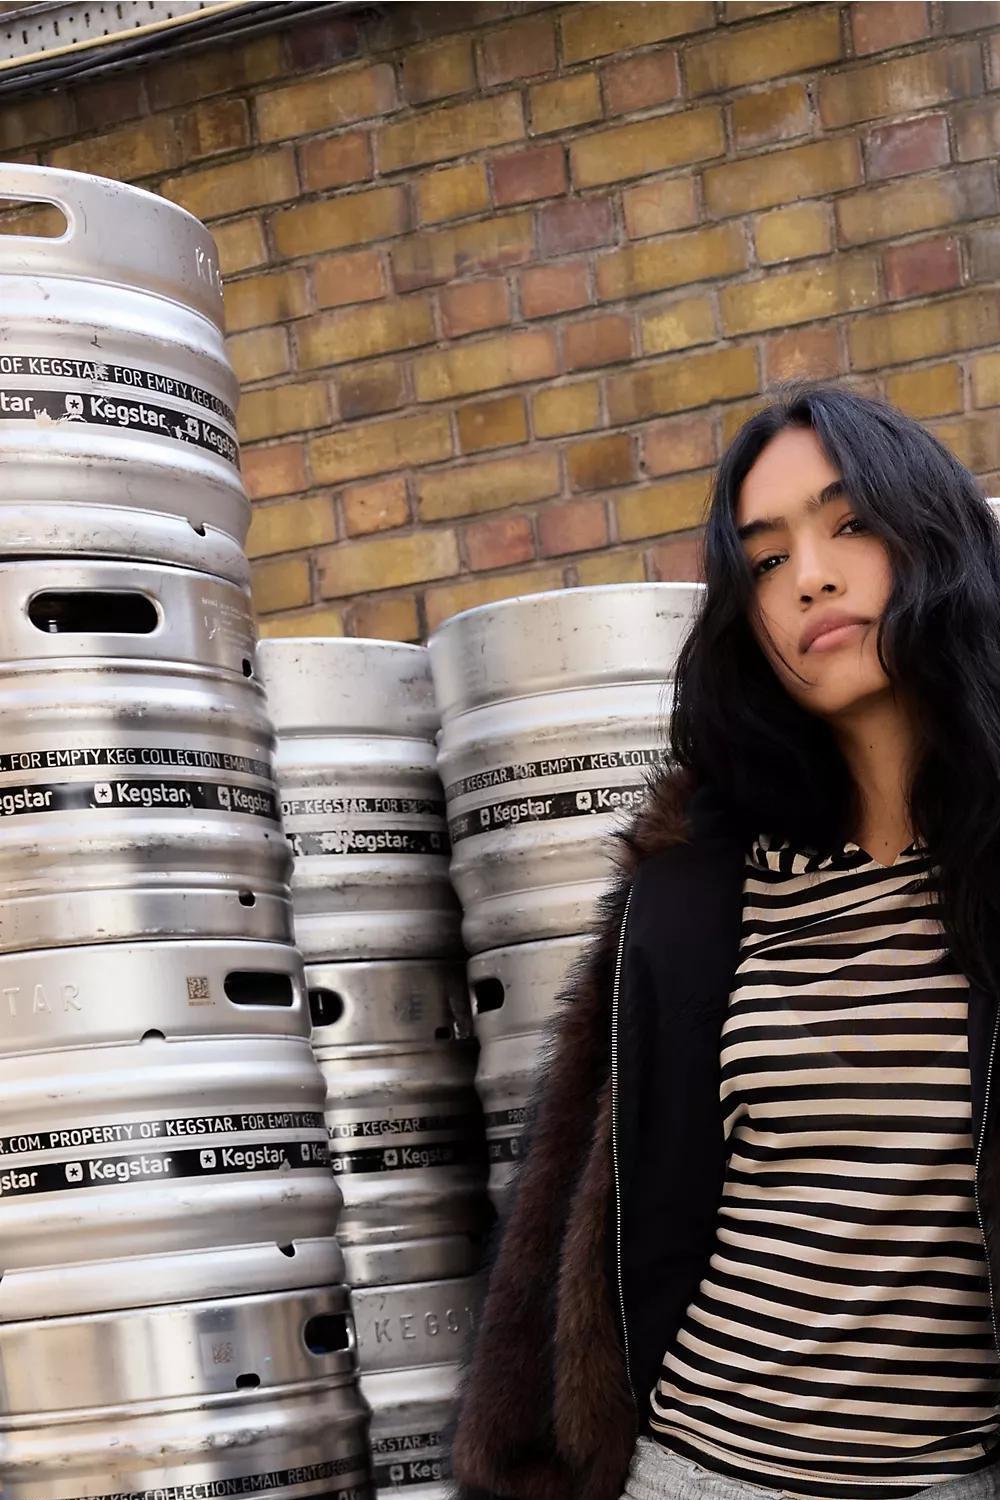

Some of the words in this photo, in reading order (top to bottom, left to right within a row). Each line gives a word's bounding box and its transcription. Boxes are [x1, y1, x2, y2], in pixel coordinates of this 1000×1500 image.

[0, 357, 22, 374] OF
[114, 366, 142, 388] FOR
[147, 373, 189, 399] EMPTY
[90, 396, 167, 428] Kegstar
[10, 752, 41, 770] FOR
[46, 749, 101, 768] EMPTY
[105, 748, 137, 765] KEG
[141, 748, 221, 769] COLLECTION
[541, 756, 585, 777] EMPTY
[590, 751, 617, 769] KEG
[116, 783, 187, 807] Kegstar
[374, 799, 399, 814] FOR
[492, 799, 553, 823] Kegstar
[49, 1125, 134, 1148] PROPERTY
[140, 1121, 161, 1138] OF
[166, 1117, 237, 1136] KEGSTAR.
[240, 1113, 266, 1131] FOR
[268, 1112, 300, 1129] EMPTY
[88, 1155, 172, 1183] Kegstar
[221, 1147, 285, 1173] Kegstar
[240, 1474, 285, 1493] EMAIL
